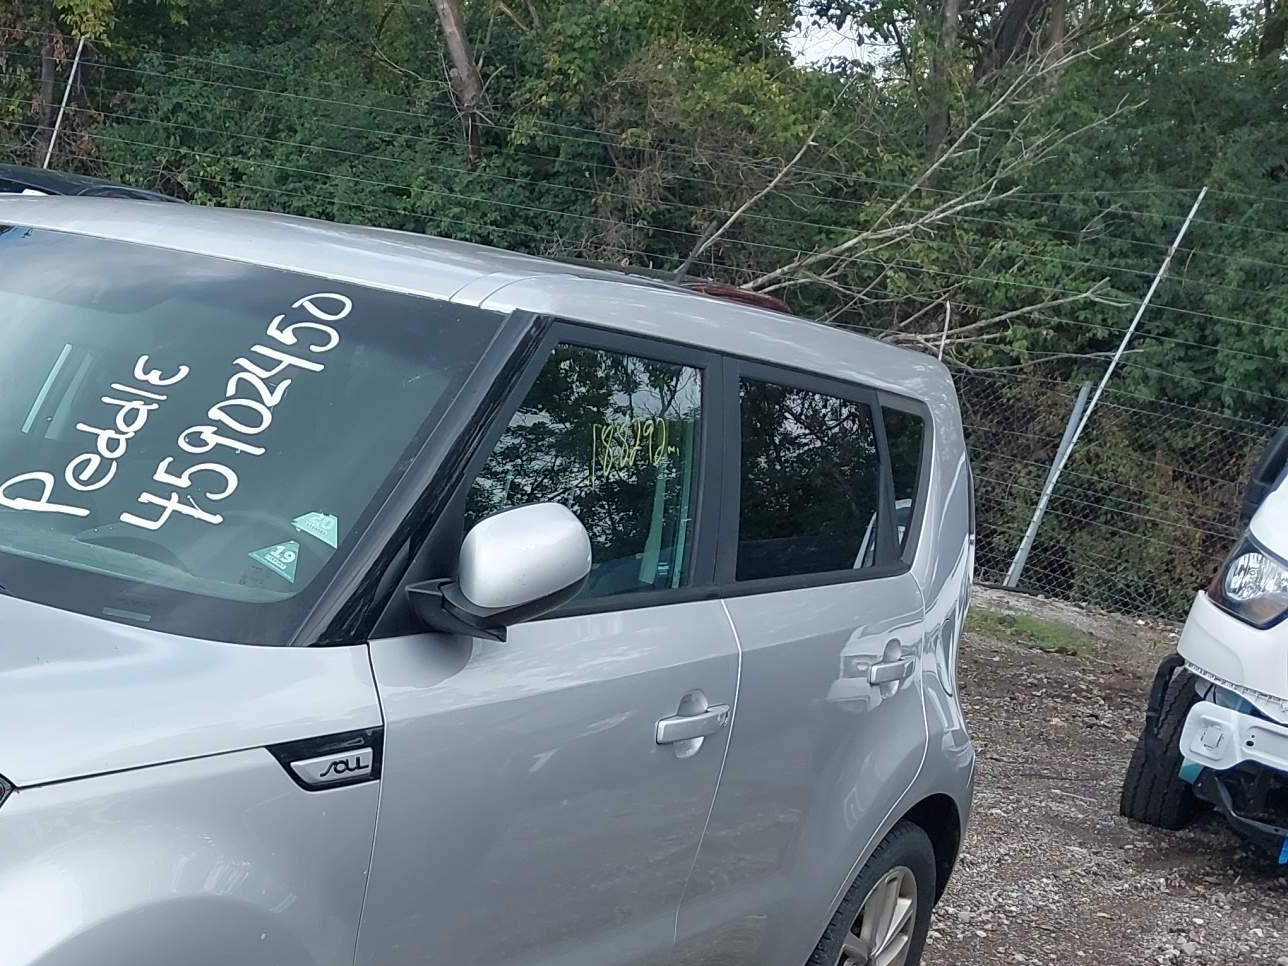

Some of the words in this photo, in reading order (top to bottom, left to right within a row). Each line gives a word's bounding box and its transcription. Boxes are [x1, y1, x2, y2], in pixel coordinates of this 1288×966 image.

[119, 292, 353, 530] 45902450
[271, 545, 296, 563] 19
[319, 756, 370, 777] SOUL
